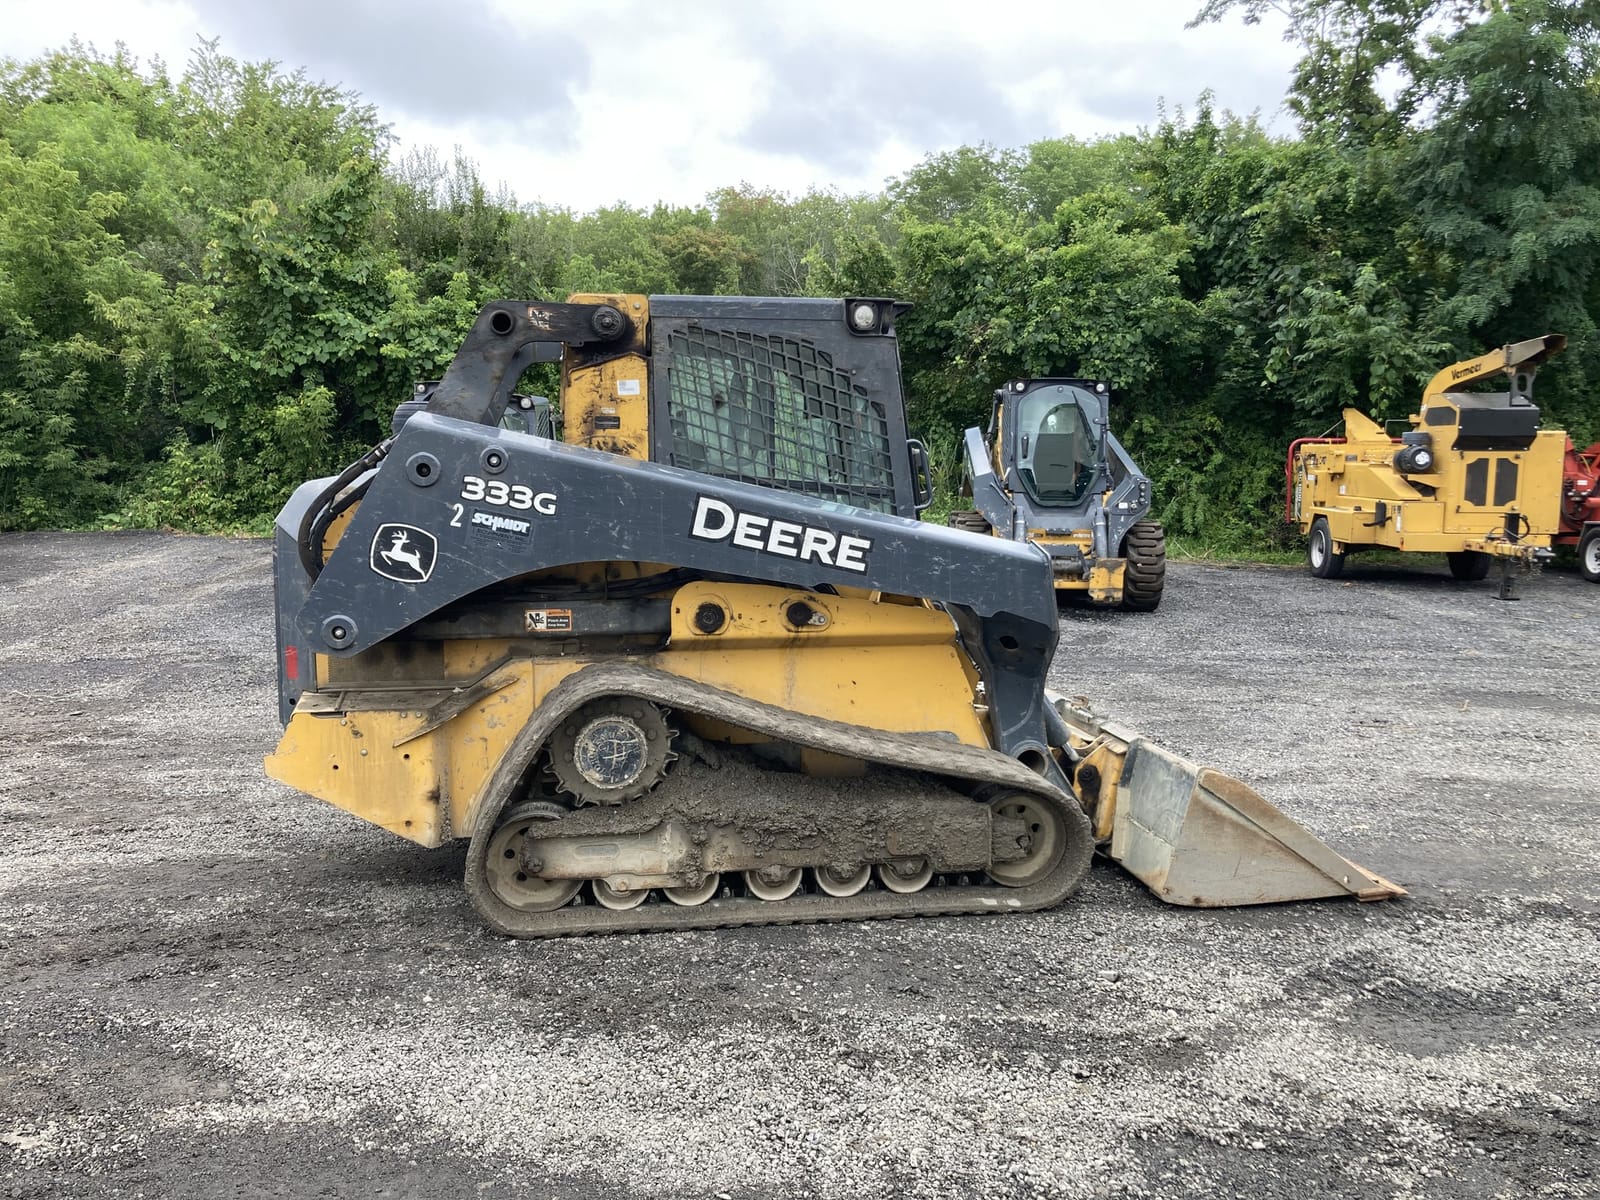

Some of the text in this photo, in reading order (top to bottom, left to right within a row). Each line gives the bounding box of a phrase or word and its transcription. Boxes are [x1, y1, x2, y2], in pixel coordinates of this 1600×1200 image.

[1451, 363, 1481, 380] Vermeer
[461, 475, 557, 515] 333G
[450, 503, 464, 527] 2
[471, 512, 530, 533] SCHMIDT
[692, 496, 871, 571] DEERE
